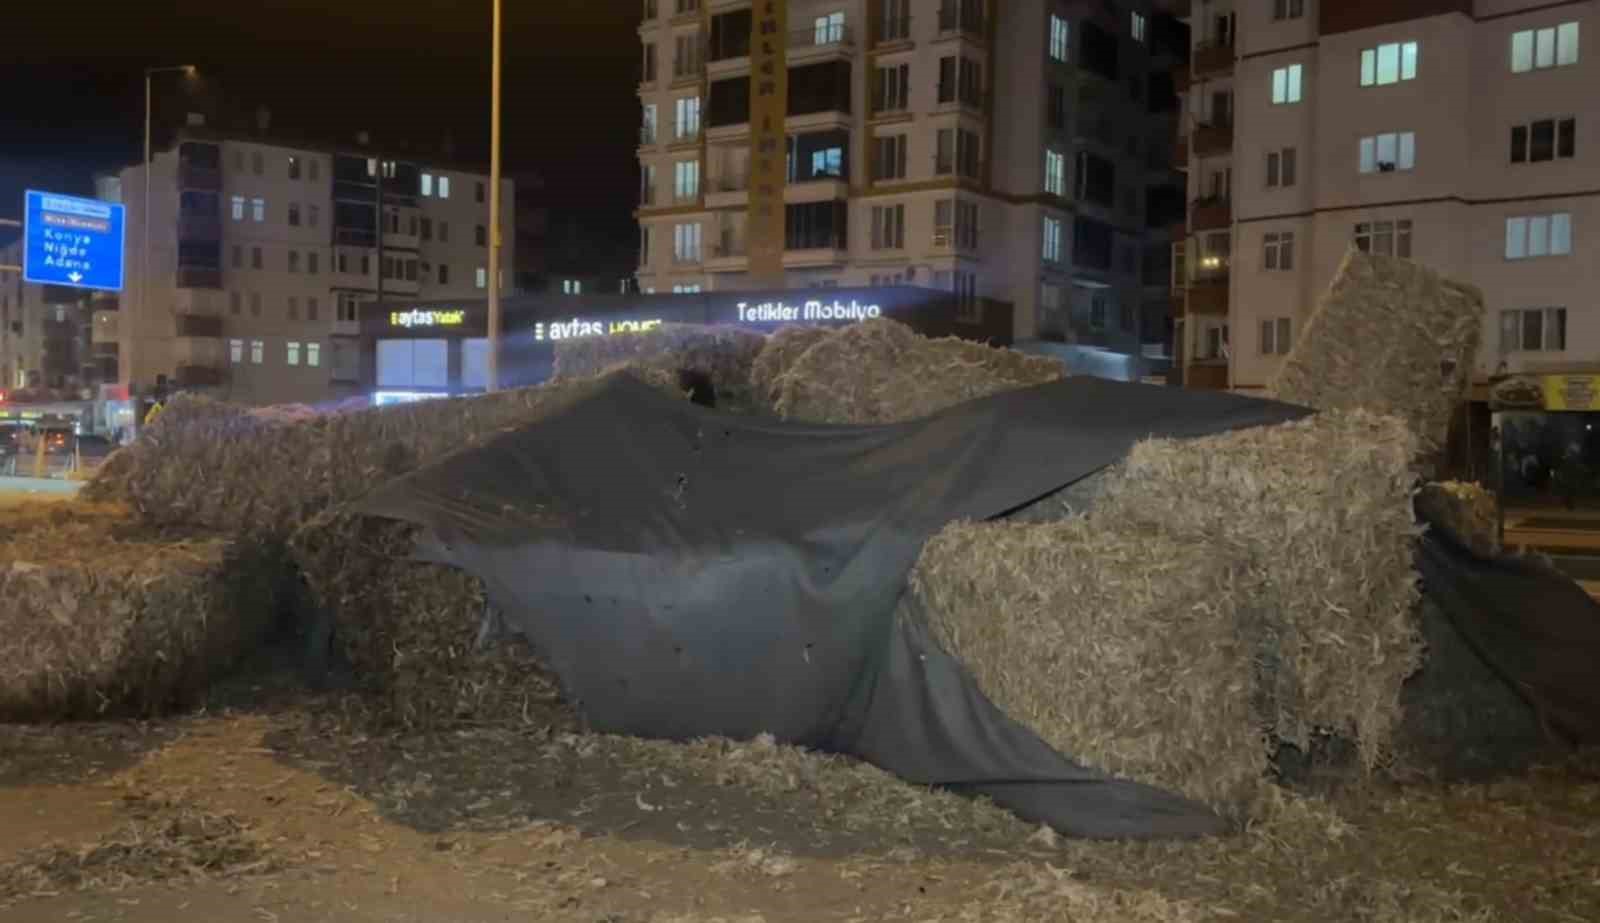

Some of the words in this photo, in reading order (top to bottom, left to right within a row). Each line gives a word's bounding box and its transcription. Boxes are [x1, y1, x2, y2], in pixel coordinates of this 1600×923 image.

[44, 228, 91, 248] Konya
[44, 255, 91, 271] Adana
[737, 301, 799, 321] Tetikler
